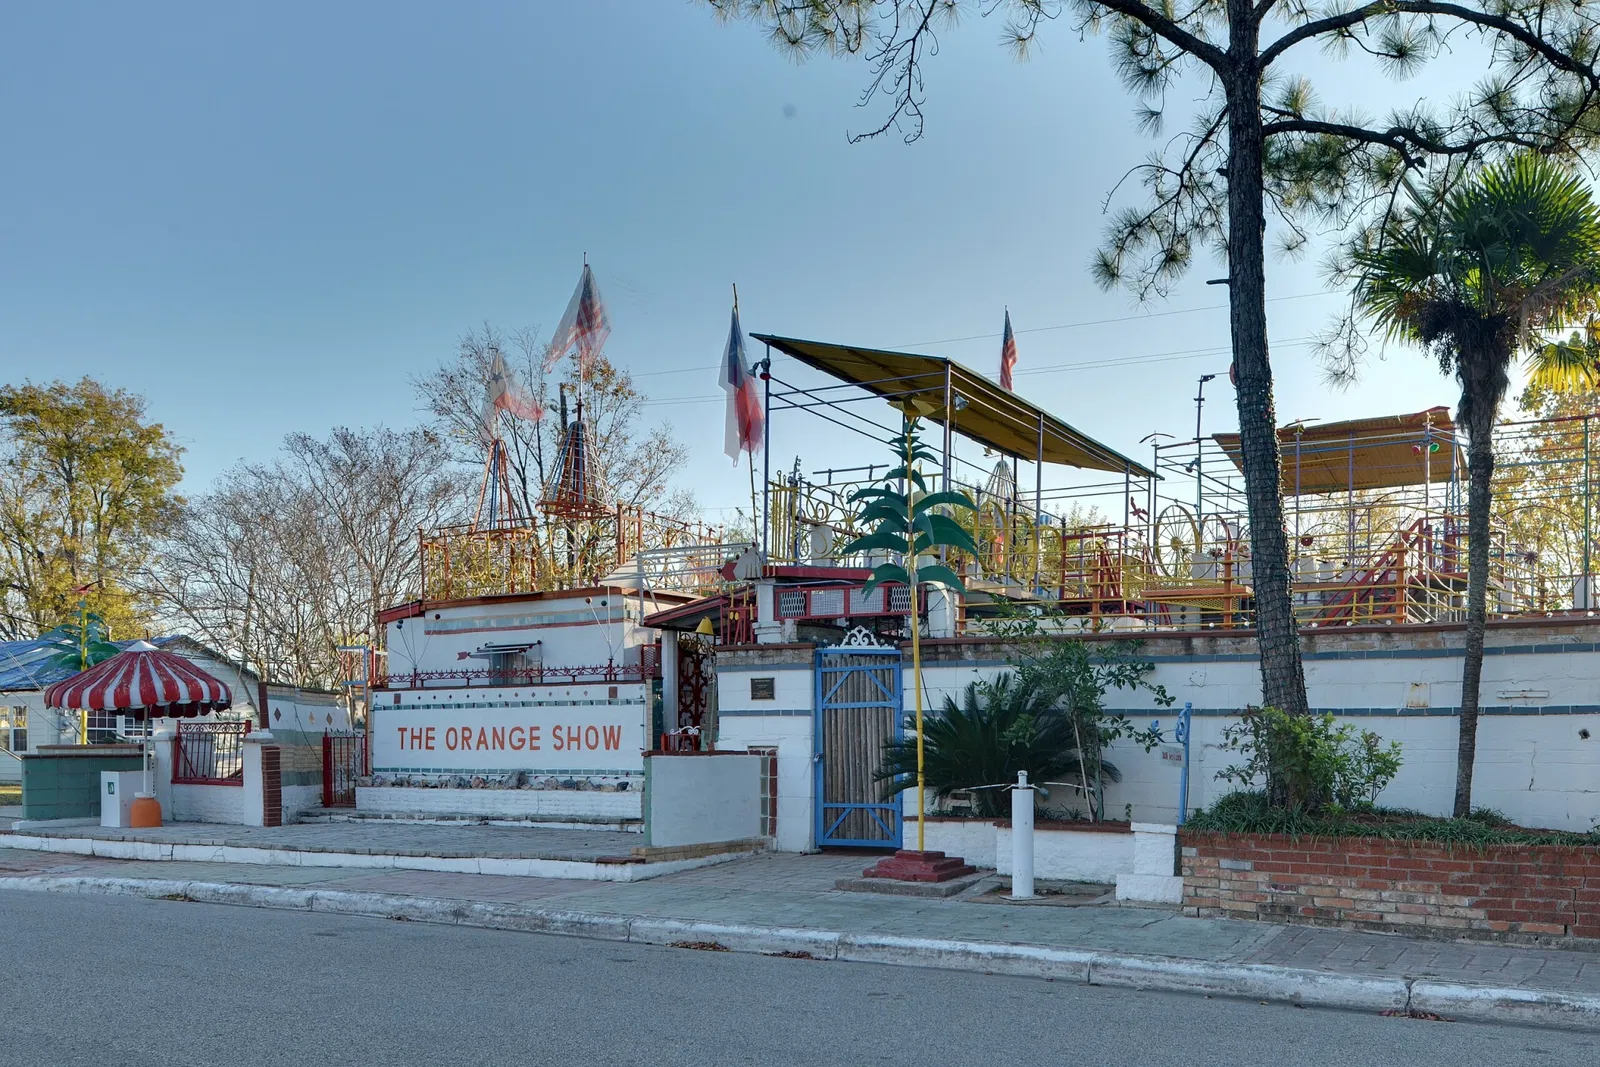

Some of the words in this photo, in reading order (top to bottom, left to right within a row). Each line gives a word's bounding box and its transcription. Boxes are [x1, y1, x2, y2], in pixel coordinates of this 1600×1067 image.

[398, 727, 435, 751] THE
[445, 726, 541, 751] ORANGE
[552, 725, 622, 751] SHOW
